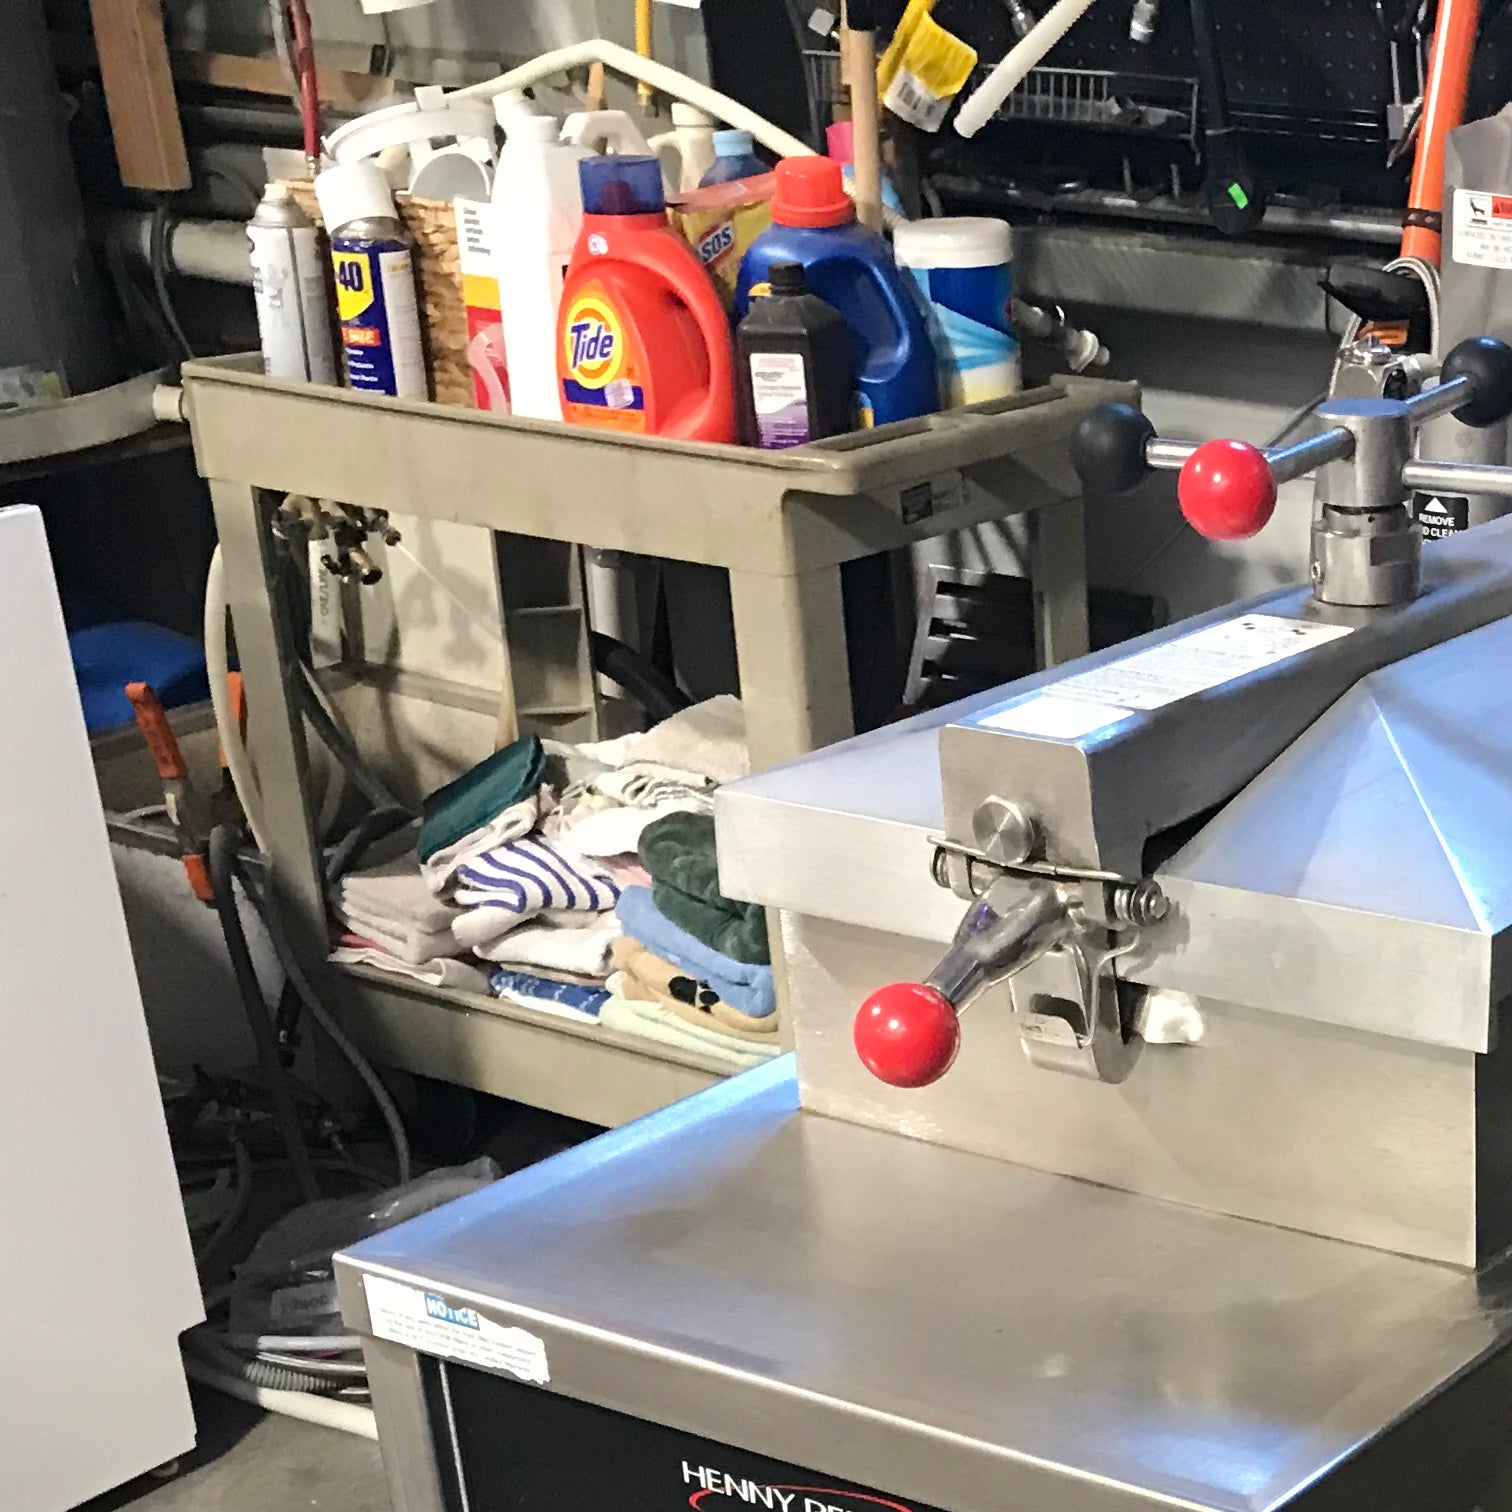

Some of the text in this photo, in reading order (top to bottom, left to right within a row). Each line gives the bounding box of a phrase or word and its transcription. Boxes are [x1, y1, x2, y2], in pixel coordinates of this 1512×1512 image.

[570, 322, 614, 369] Tide
[1419, 513, 1455, 527] REMOVE
[1430, 527, 1457, 538] CLEA
